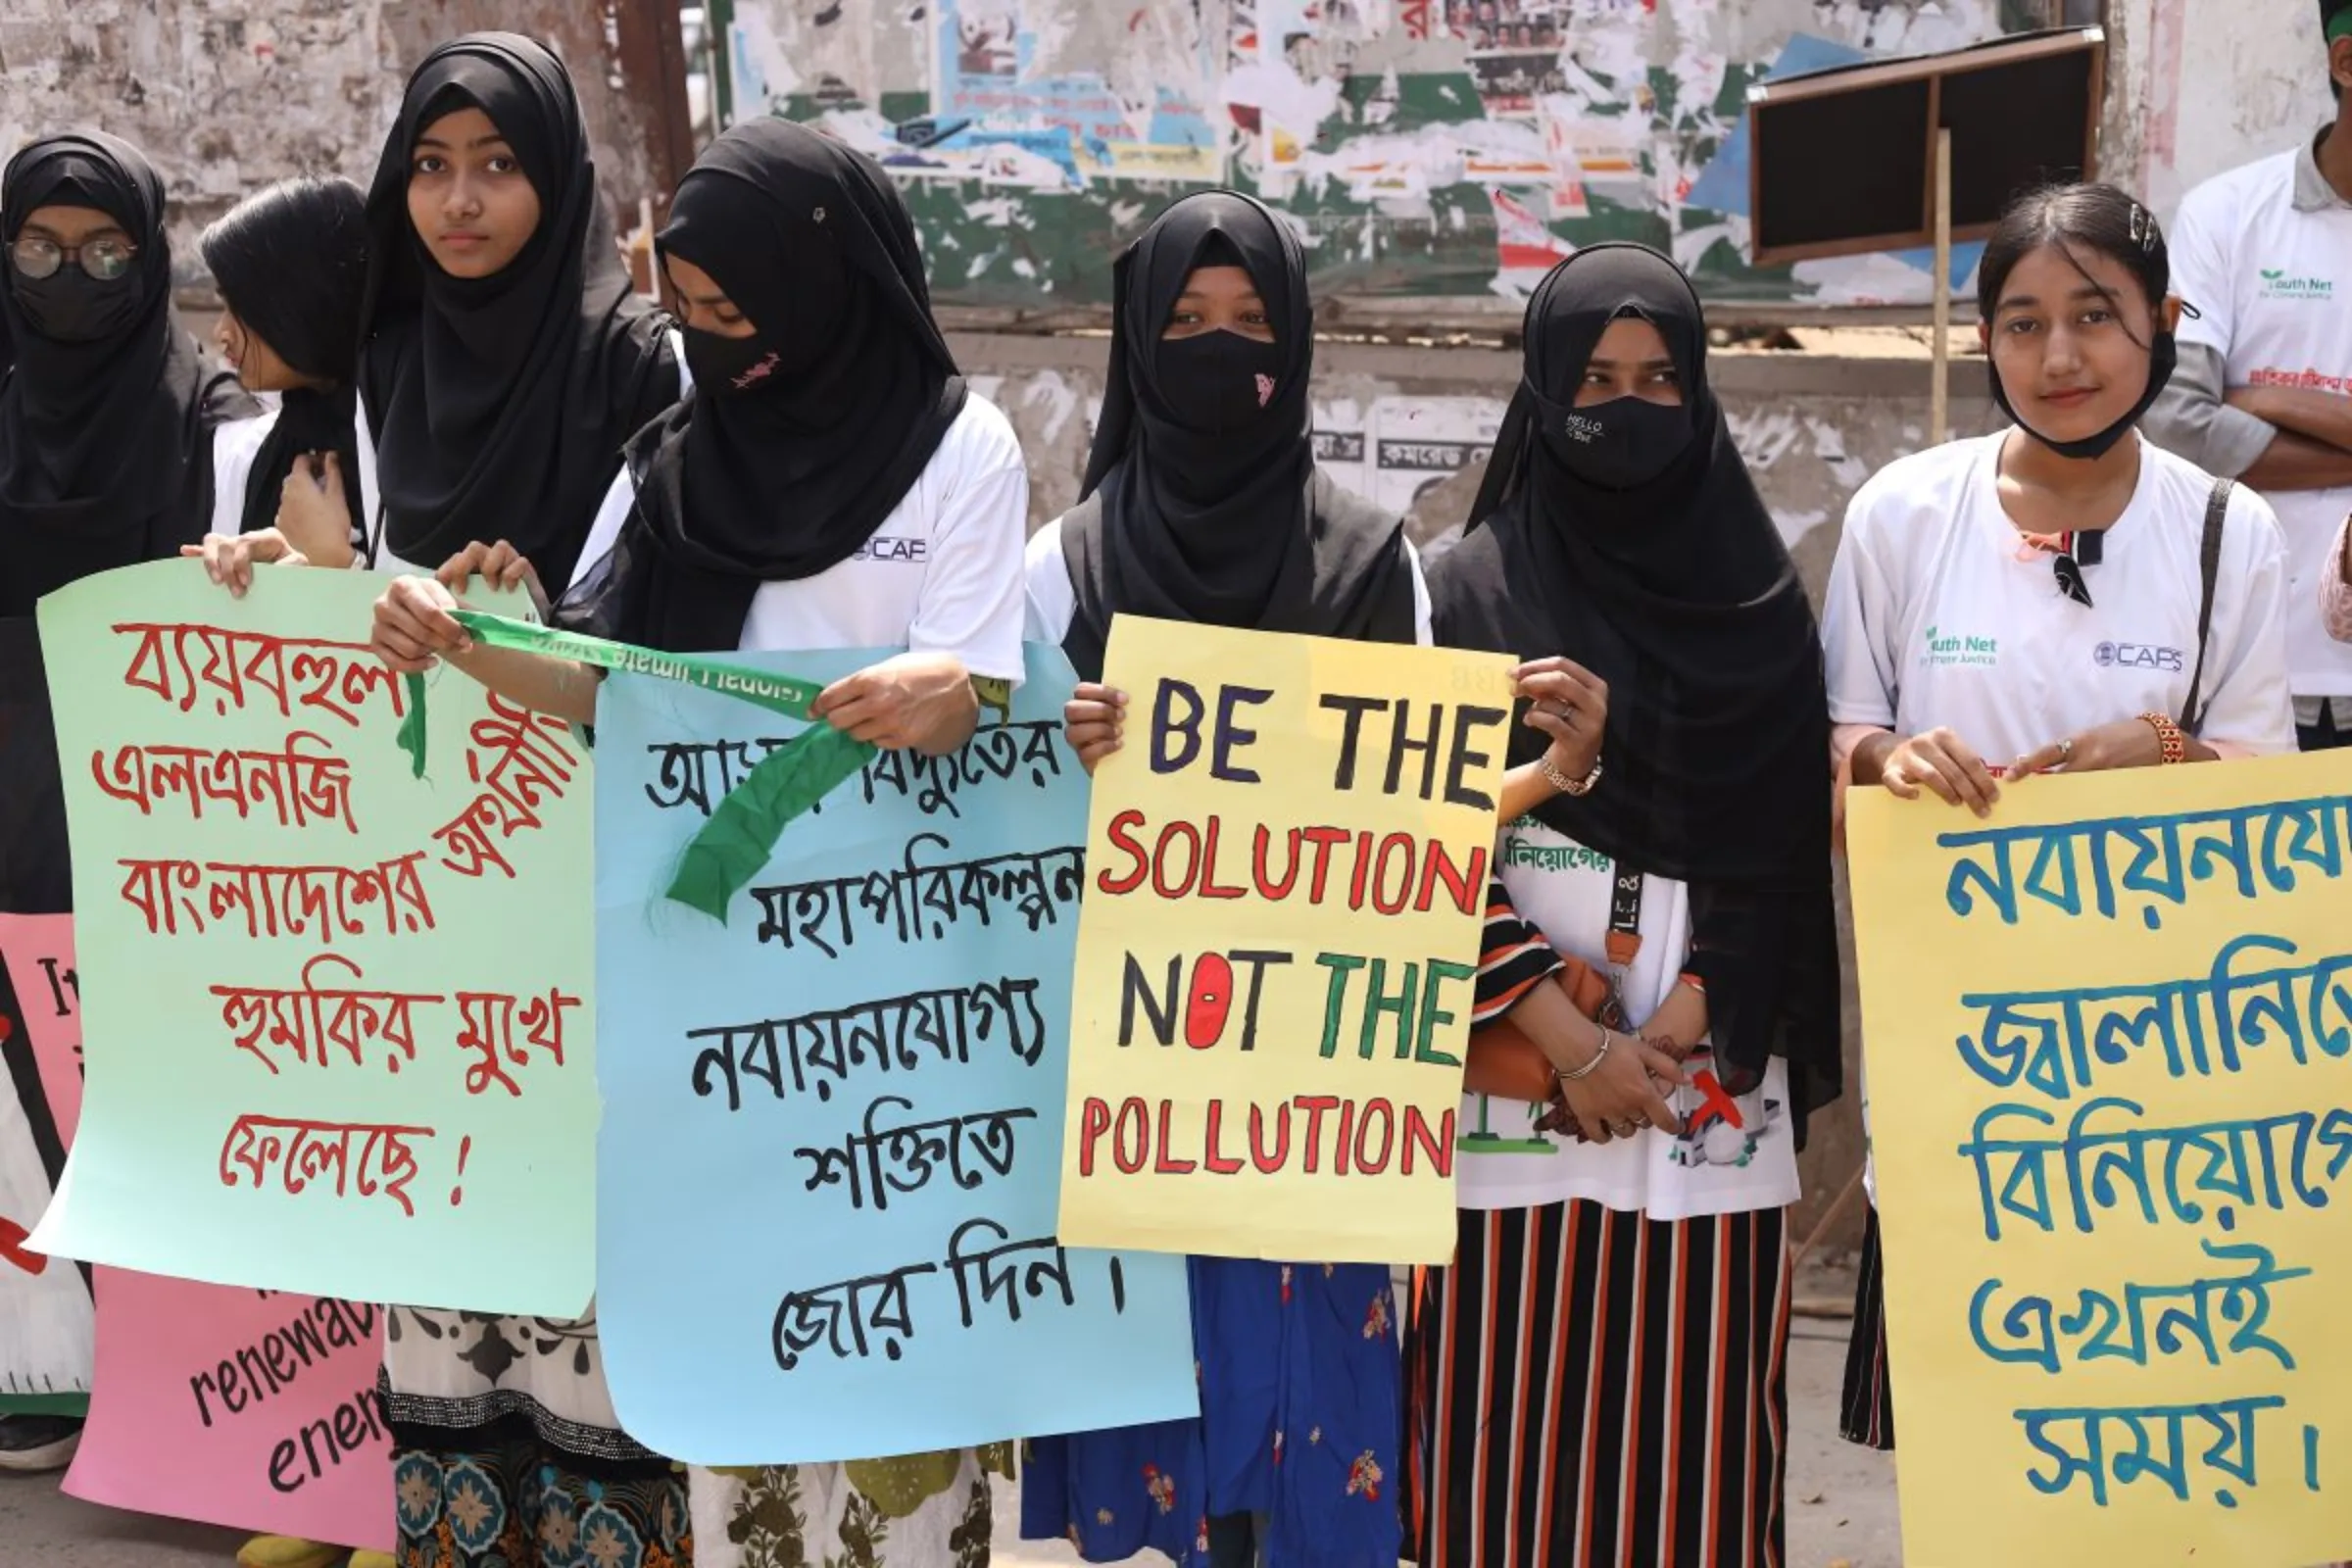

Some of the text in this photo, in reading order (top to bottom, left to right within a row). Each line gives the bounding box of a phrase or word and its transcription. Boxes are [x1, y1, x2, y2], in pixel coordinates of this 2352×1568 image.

[2310, 278, 2332, 291] Net
[112, 623, 404, 726] ব্যয়বহুল
[1966, 636, 1997, 653] Net
[2117, 641, 2182, 672] CAPS
[92, 730, 359, 833] এলএনজি
[1150, 677, 1507, 810] BE THE
[118, 851, 435, 942] বাংলাদেশের
[750, 833, 1086, 958] মহাপরিকল্পন
[1097, 809, 1486, 916] SOLUTION
[210, 954, 445, 1074] হুমকির
[456, 988, 581, 1096] মুখে
[686, 976, 1046, 1110] নবায়নযোগ্য
[1118, 949, 1477, 1066] NOT THE
[794, 1096, 1038, 1209] শক্তিতে
[1079, 1096, 1454, 1178] POLLUTION
[772, 1262, 937, 1370] জোর
[944, 1218, 1074, 1327] দিন
[1969, 1239, 2313, 1373] এখনই
[190, 1298, 381, 1427] renewab
[269, 1388, 398, 1493] ener
[2014, 1396, 2286, 1508] সময়
